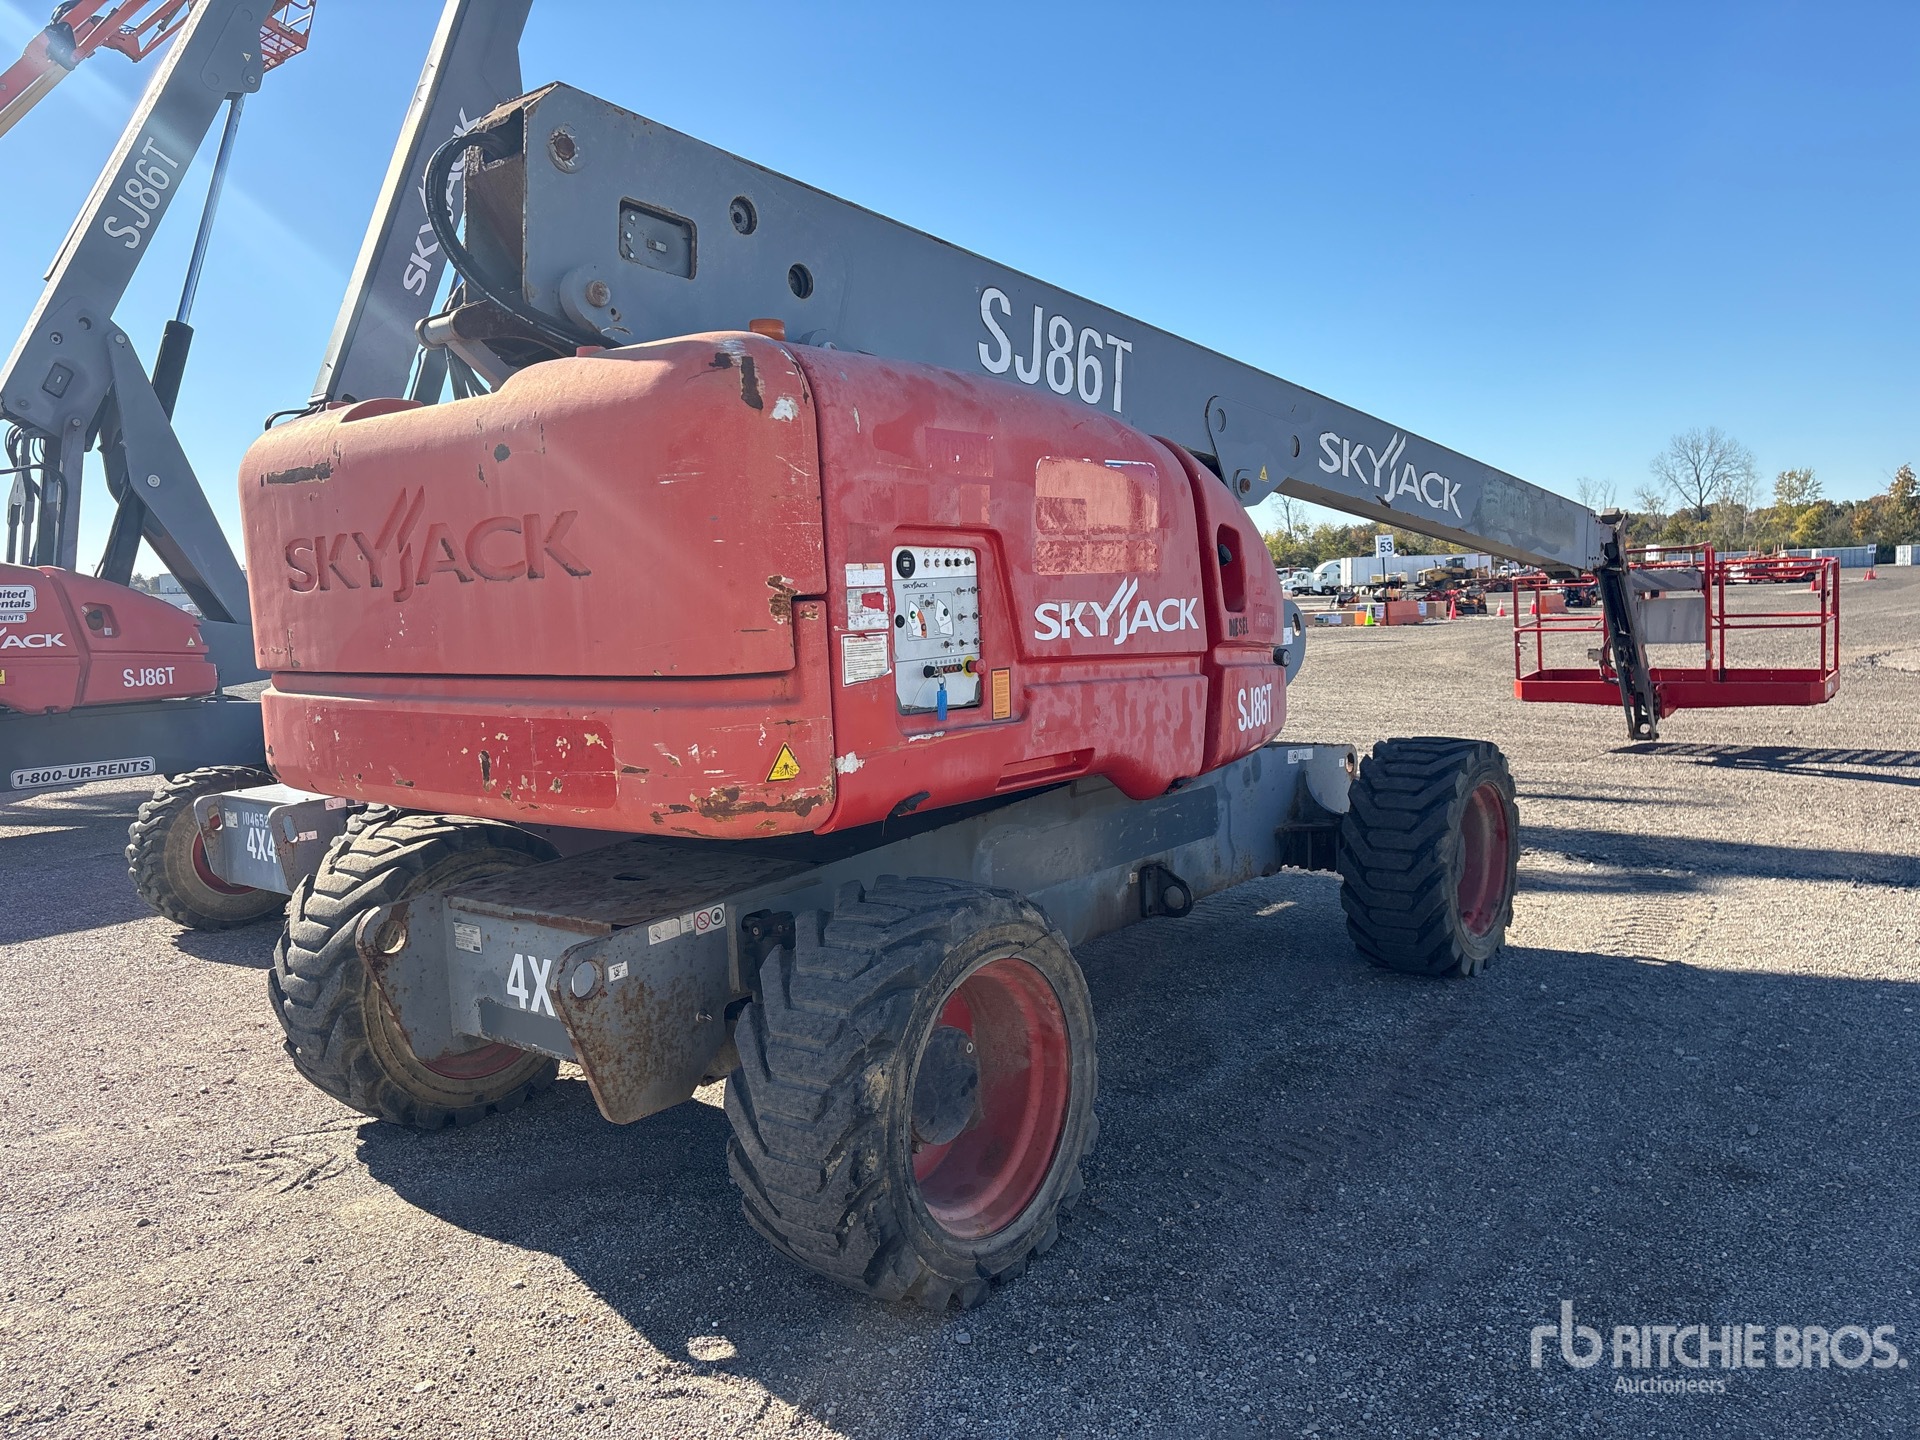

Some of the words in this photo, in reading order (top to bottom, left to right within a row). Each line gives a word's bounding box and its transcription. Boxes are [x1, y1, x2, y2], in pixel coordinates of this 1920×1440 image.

[103, 136, 179, 249] SJ86T
[978, 287, 1133, 414] SJ86T
[1318, 431, 1463, 519] SKYJACK
[285, 485, 592, 603] SKYJACK
[1380, 541, 1392, 552] 53
[0, 589, 27, 599] ited
[0, 599, 31, 608] ntals
[903, 581, 929, 590] SKYJACK
[1034, 576, 1200, 646] SKYJACK
[123, 666, 176, 688] SJ86T
[1237, 683, 1272, 732] SJ86T
[16, 760, 151, 785] 1-800-UR-RENTS
[246, 827, 277, 864] 4X4
